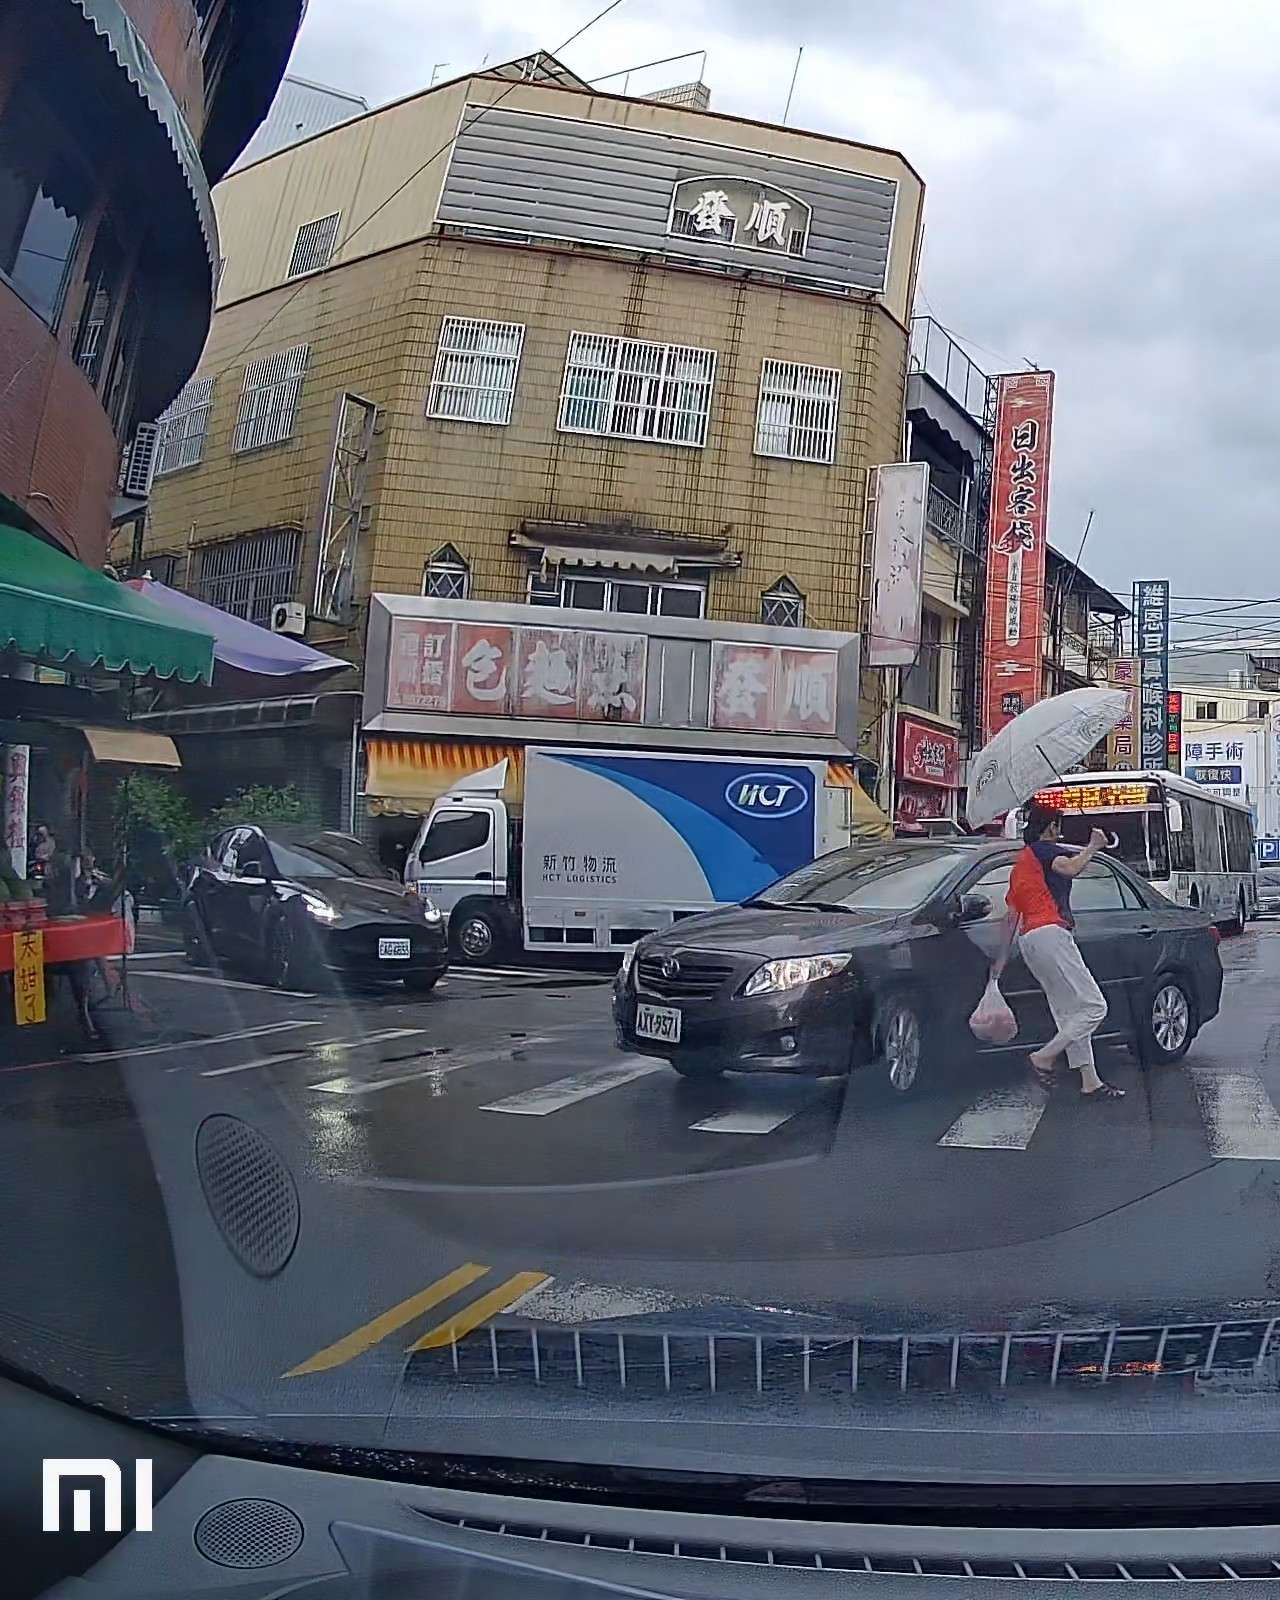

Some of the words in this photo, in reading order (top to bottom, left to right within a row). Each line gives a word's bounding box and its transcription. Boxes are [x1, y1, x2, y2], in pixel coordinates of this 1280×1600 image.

[737, 784, 793, 808] HCT
[543, 854, 617, 873] 新竹物流
[566, 874, 617, 884] LOGISTICS
